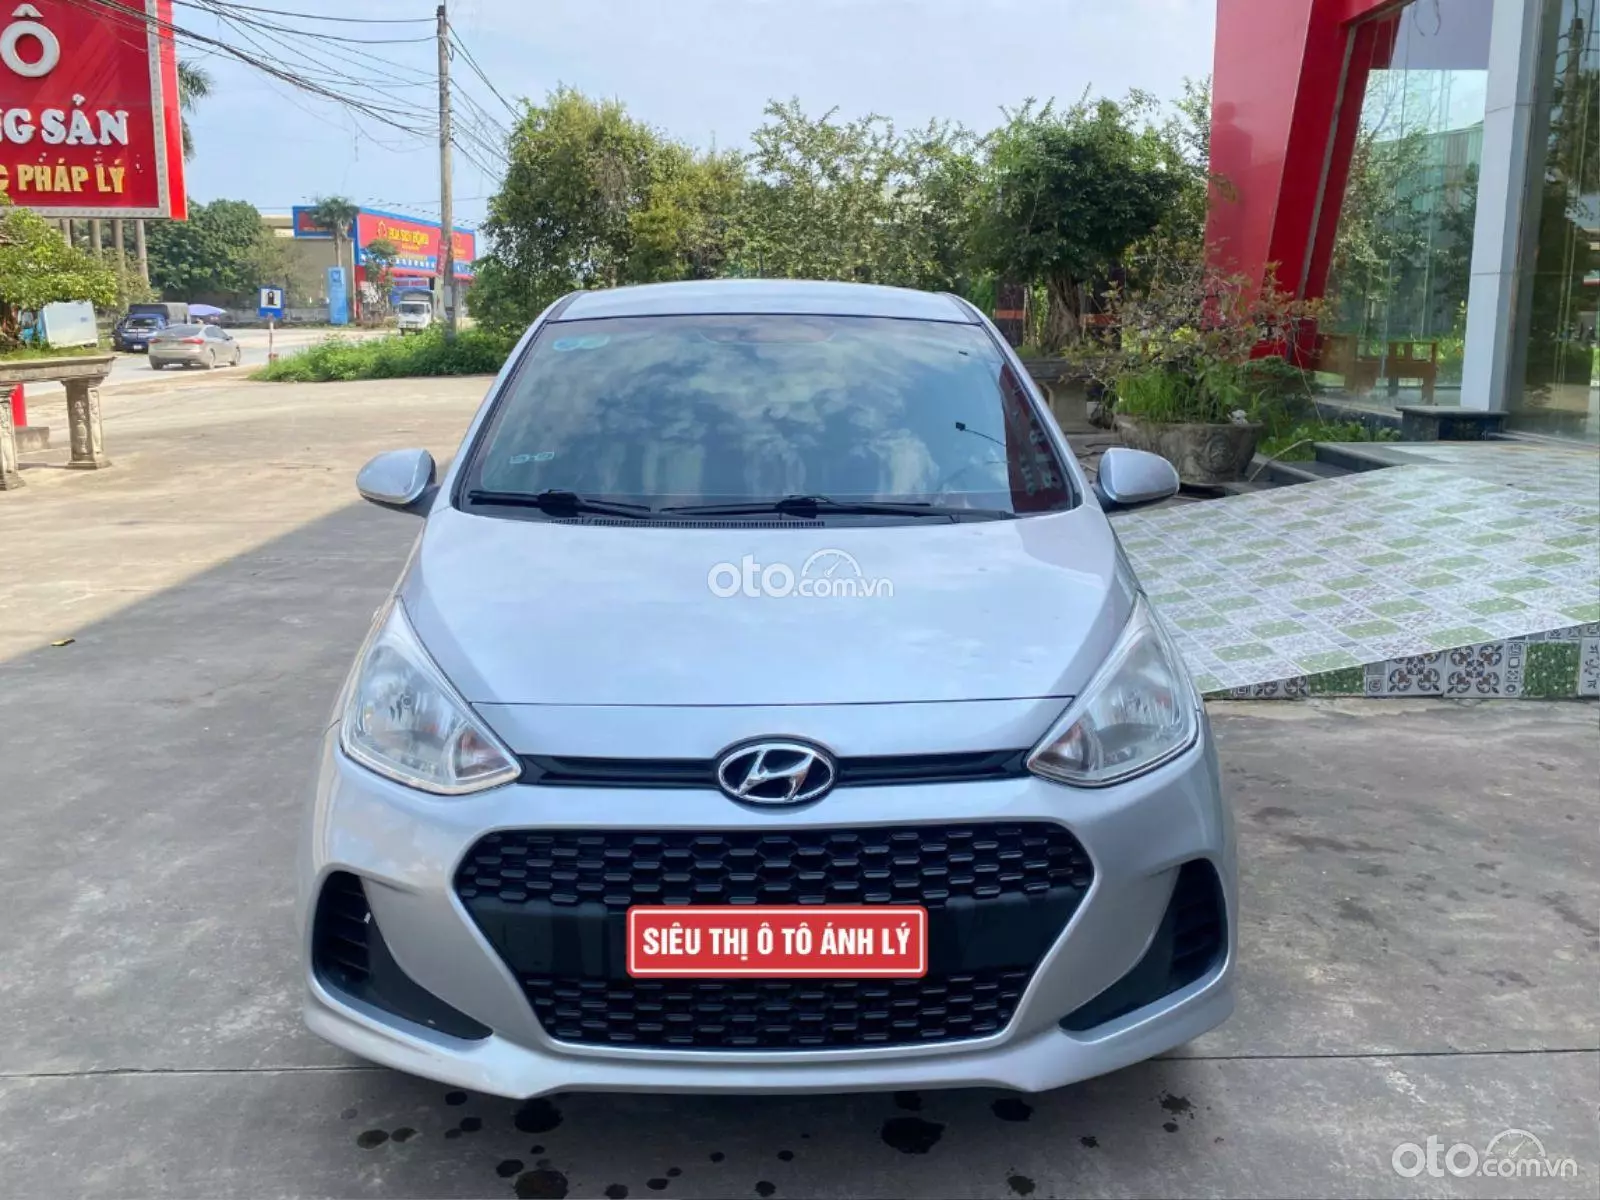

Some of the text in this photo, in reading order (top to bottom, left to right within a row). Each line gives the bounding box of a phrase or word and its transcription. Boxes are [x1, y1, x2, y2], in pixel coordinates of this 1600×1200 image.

[0, 3, 61, 77] Ô
[0, 93, 130, 146] G SẢN
[17, 158, 90, 192] PHÁP
[94, 159, 126, 194] LÝ
[642, 922, 911, 961] SIÊU THỊ Ô TÔ ÁNH LÝ
